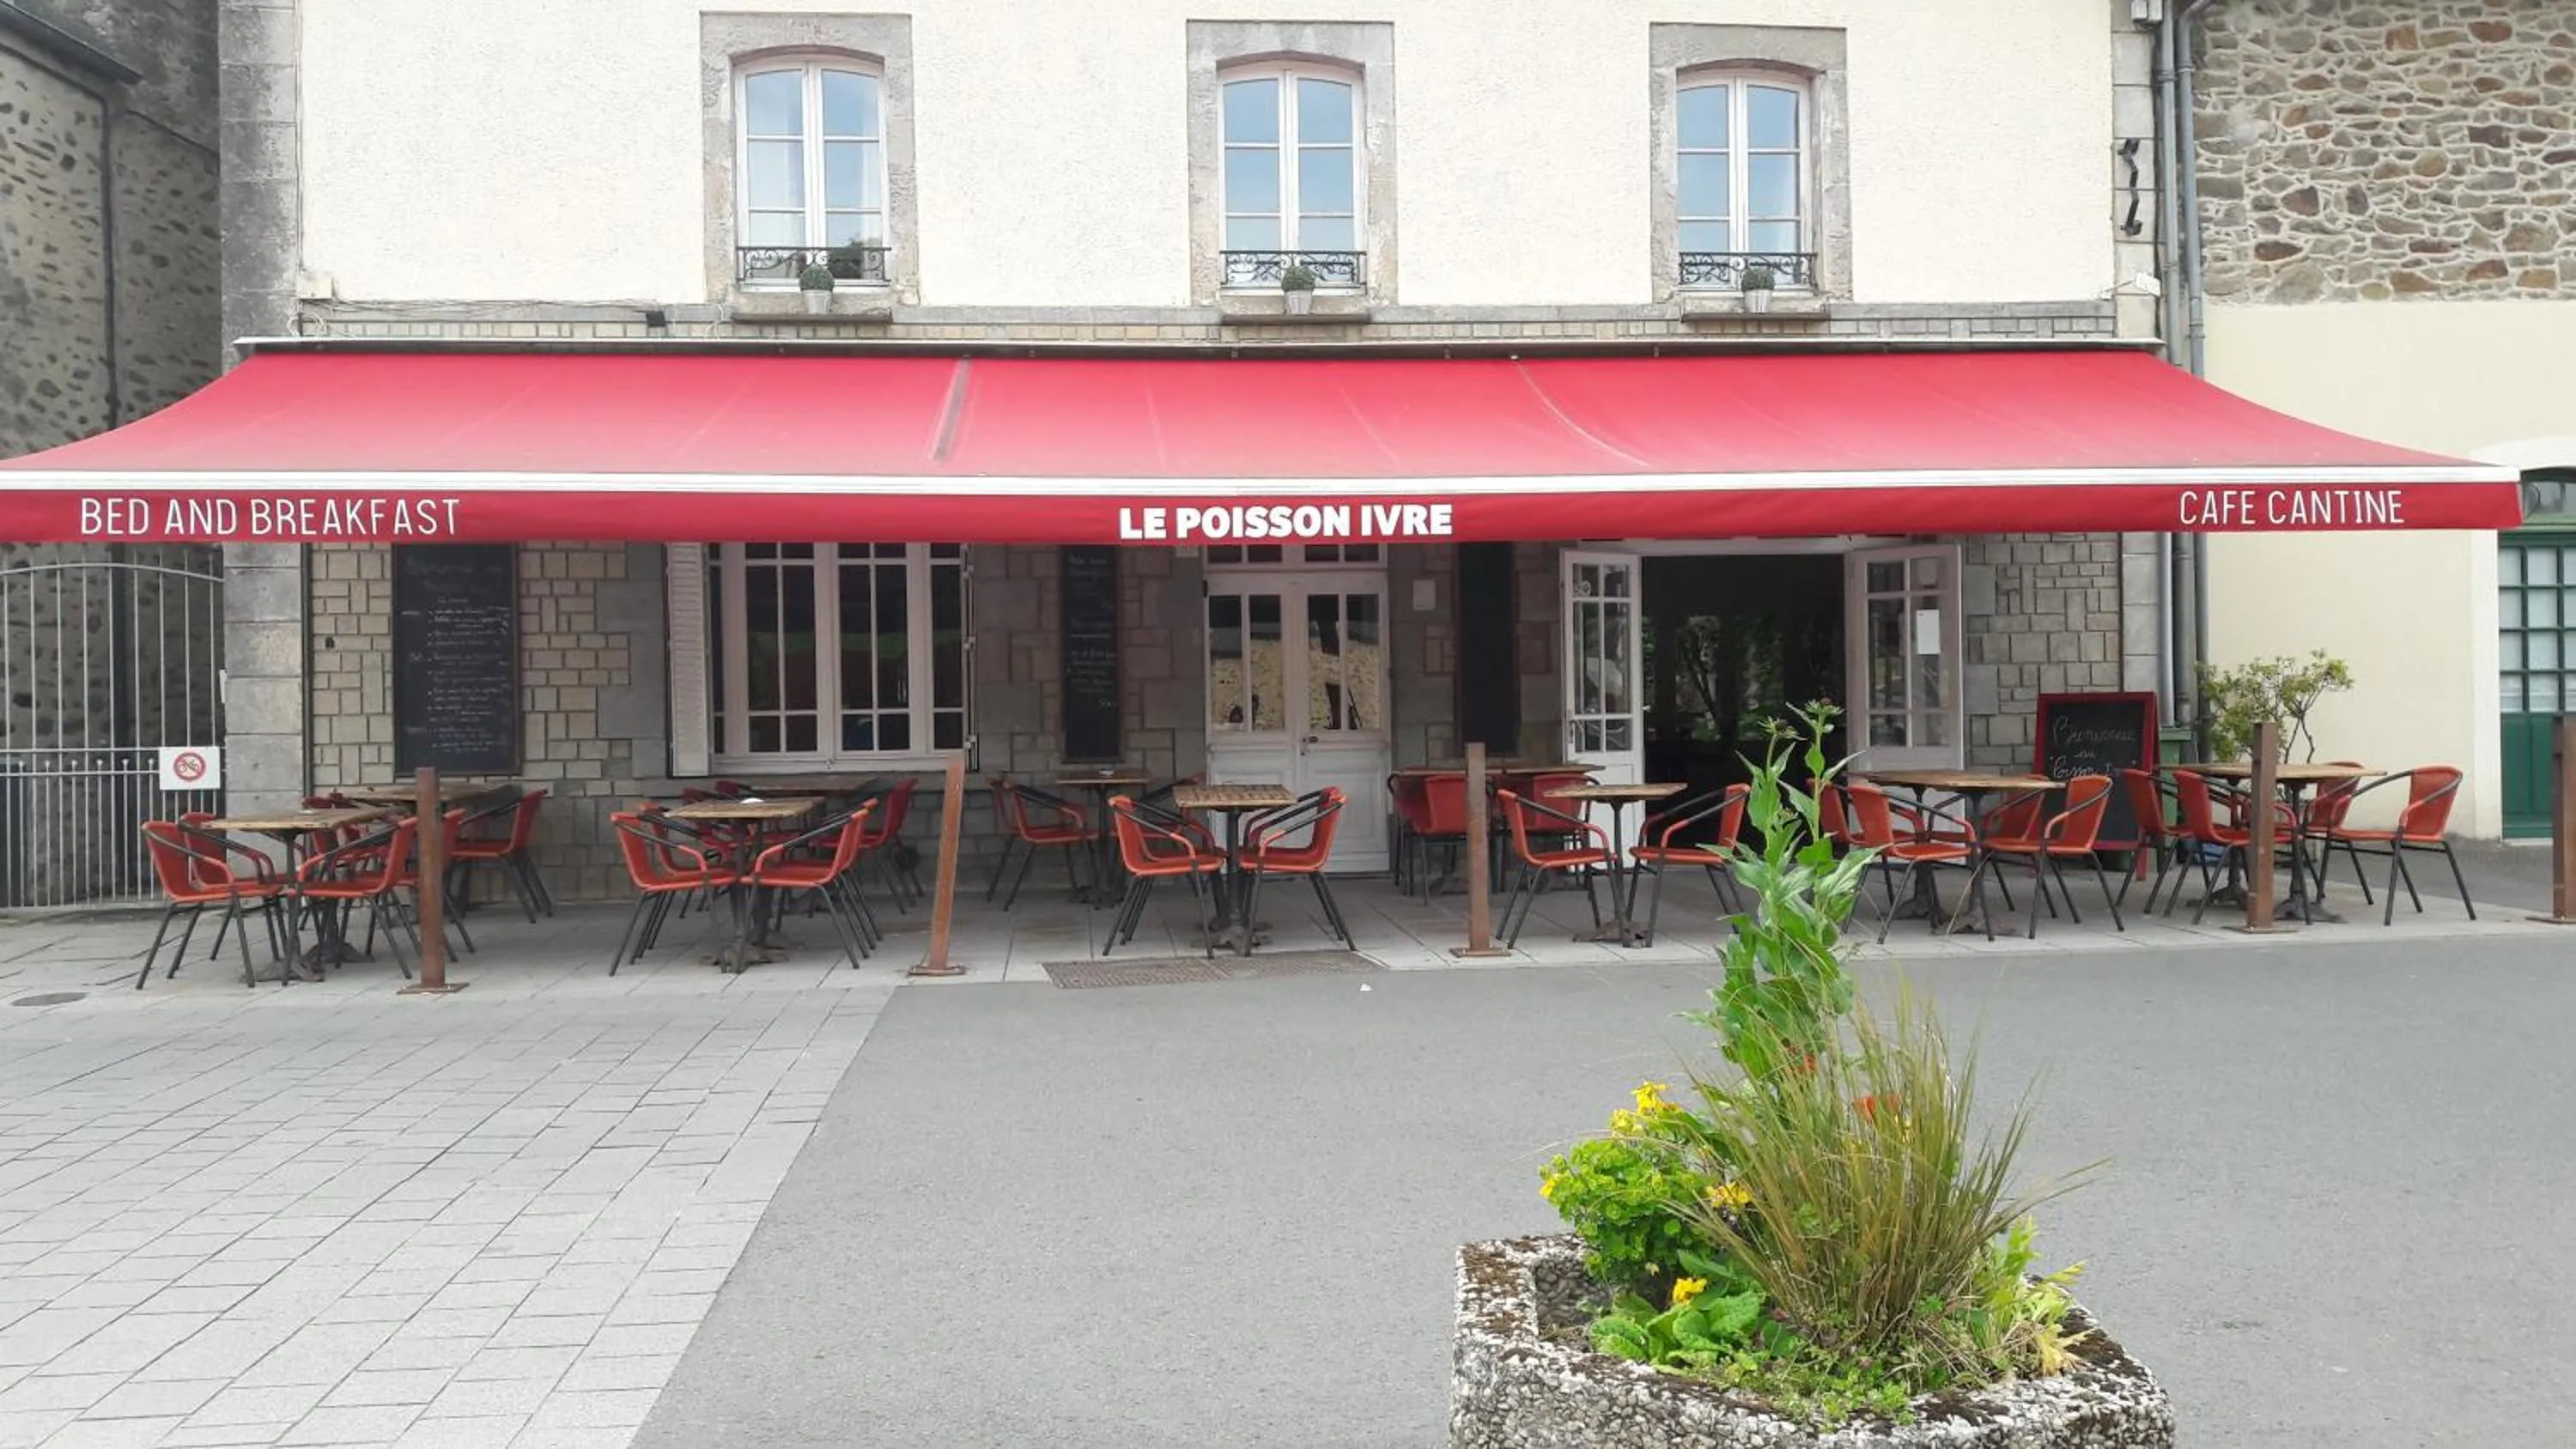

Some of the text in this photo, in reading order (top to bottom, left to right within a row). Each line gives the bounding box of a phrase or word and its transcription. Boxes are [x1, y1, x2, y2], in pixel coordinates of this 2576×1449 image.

[81, 498, 460, 535] BED AND BREAKFAST
[1119, 504, 1453, 539] LE POISSON IVRE
[2180, 490, 2404, 524] CAFE CANTINE
